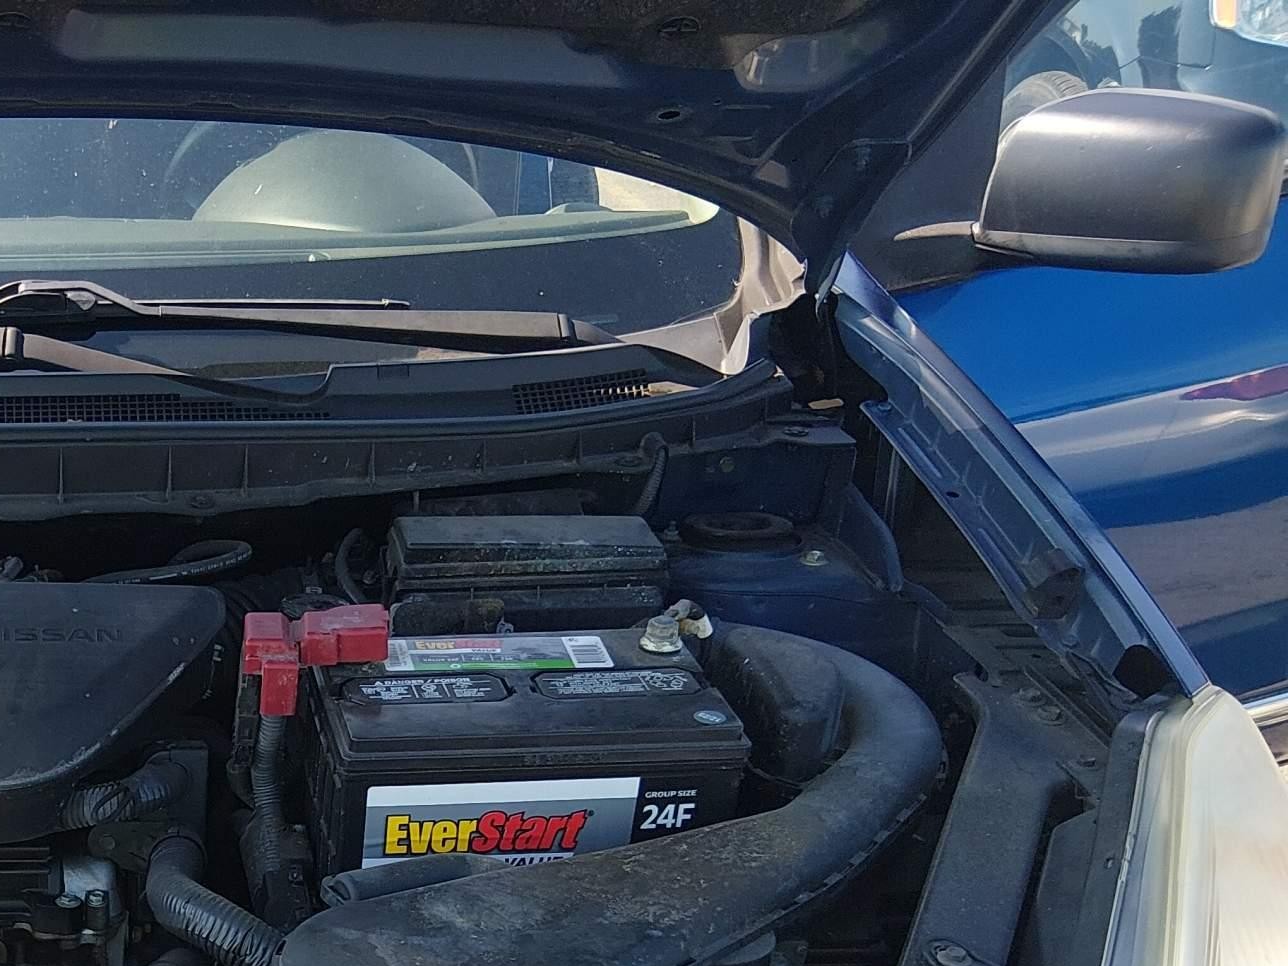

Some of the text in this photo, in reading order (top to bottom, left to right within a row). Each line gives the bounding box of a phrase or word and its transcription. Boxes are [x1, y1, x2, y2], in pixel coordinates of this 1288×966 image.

[644, 788, 697, 799] GROUP SIZE
[640, 803, 696, 831] 24F
[384, 808, 589, 855] EverStart
[504, 856, 564, 866] VAL
